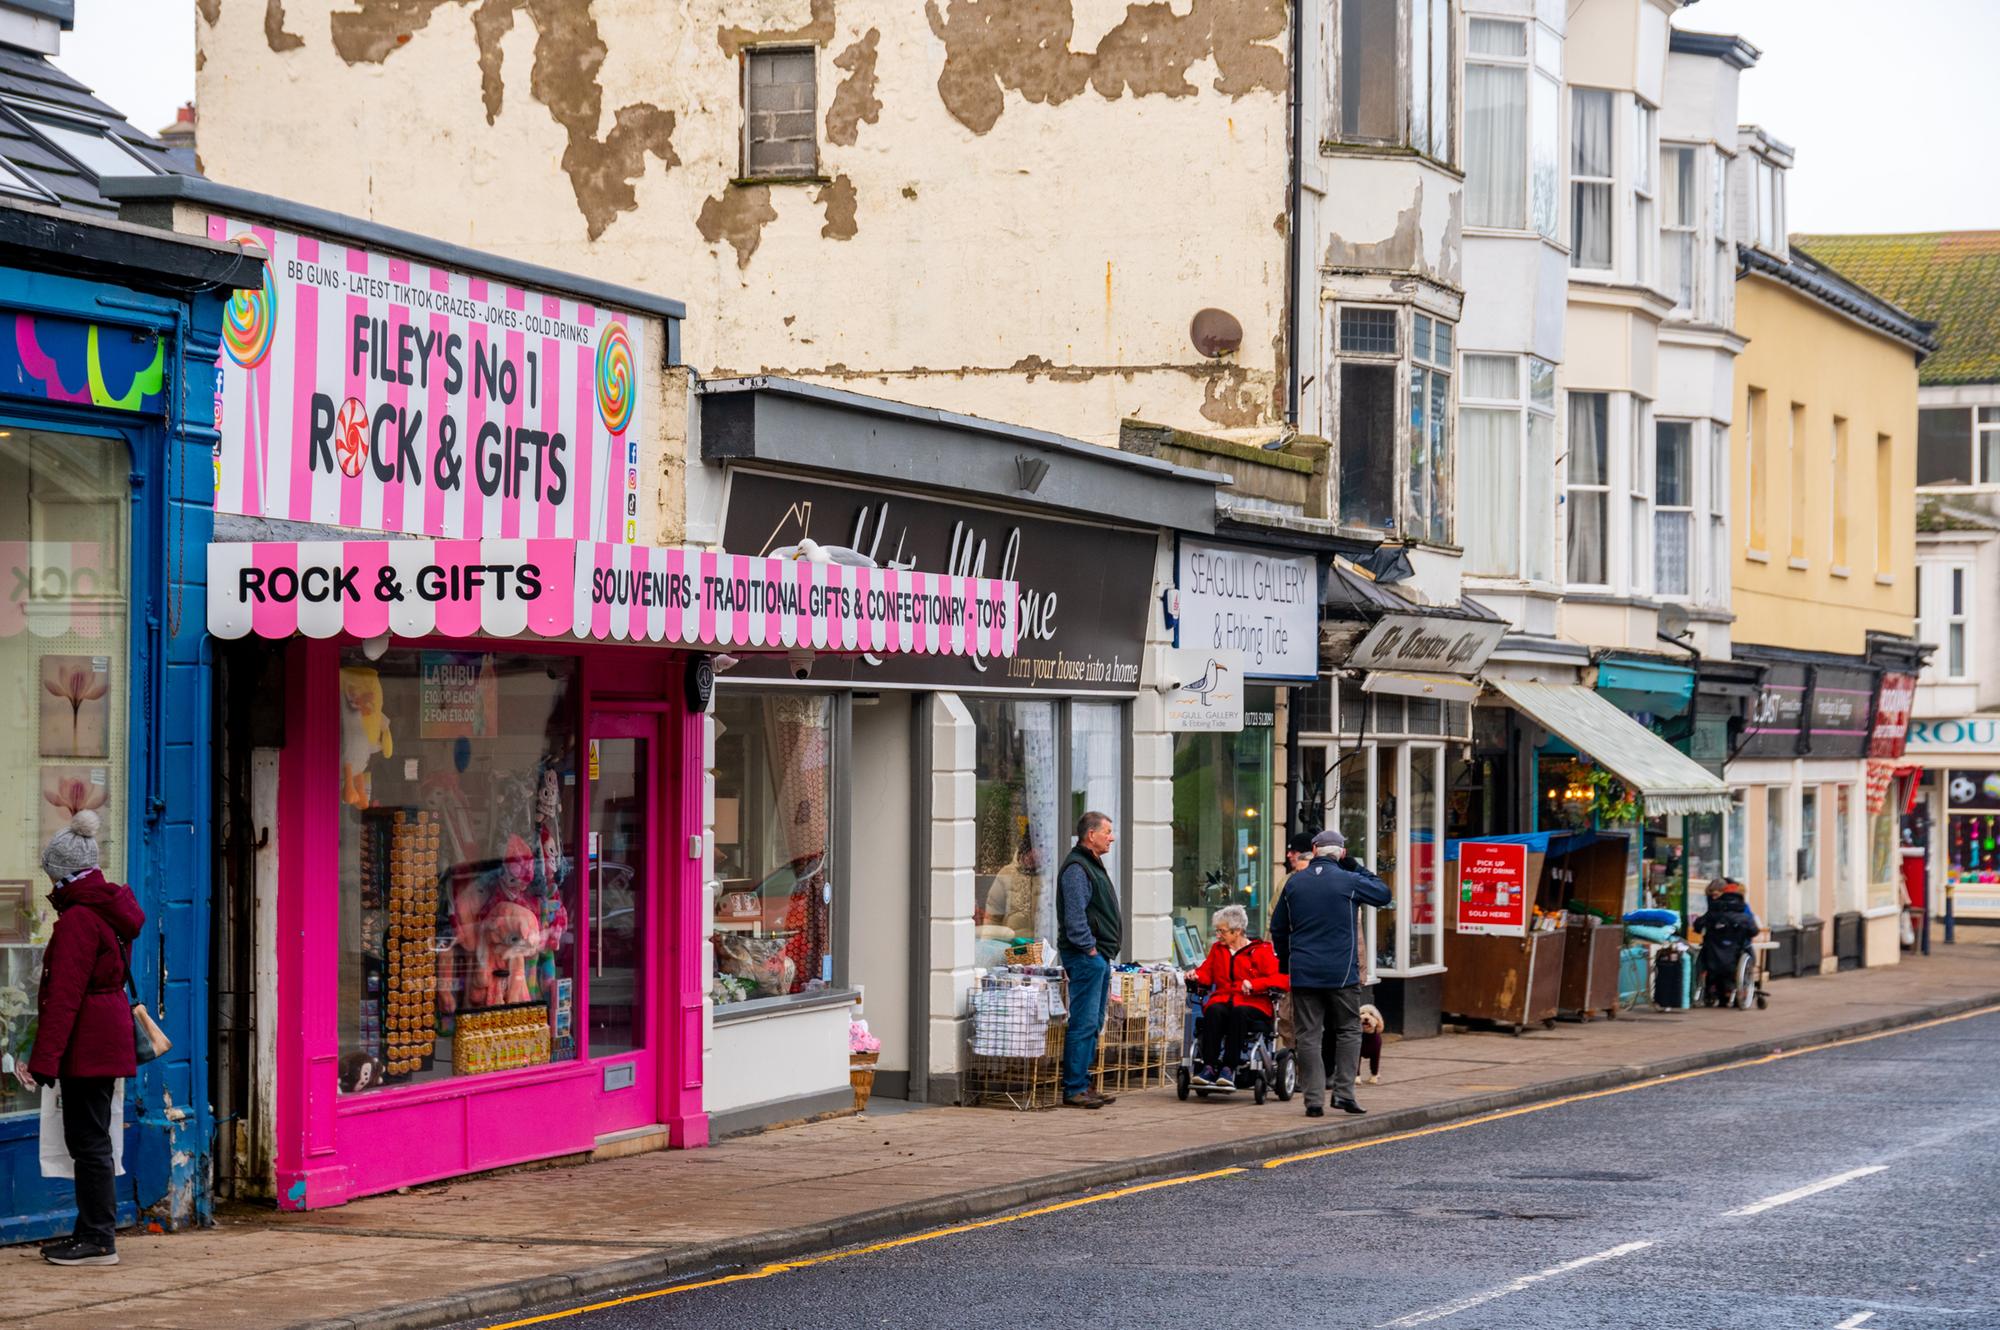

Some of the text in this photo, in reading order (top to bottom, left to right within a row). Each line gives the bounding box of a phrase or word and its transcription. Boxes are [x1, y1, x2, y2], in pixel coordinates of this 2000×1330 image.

[287, 260, 303, 280] BB
[306, 265, 340, 289] GUNS
[349, 274, 391, 300] LATEST
[393, 284, 433, 310] TIKTOK
[435, 294, 476, 320] CRAZES
[484, 305, 517, 329] JOKES
[525, 315, 551, 336] COLD
[553, 322, 589, 345] DRINKS
[353, 314, 537, 409] FILEY'S No 1
[434, 414, 463, 491] &
[475, 421, 567, 506] GIFTS
[239, 563, 542, 603] ROCK & GIFTS
[1191, 552, 1308, 604] SEAGULL GALLERY
[592, 567, 691, 609] SOUVENIRS
[704, 576, 806, 616] TRADITIONAL
[809, 584, 850, 619] GIFTS
[853, 588, 864, 620] &
[867, 589, 966, 627] CONFECTIONRY
[976, 598, 1006, 630] TOYS
[1213, 613, 1288, 665] & Ebbing Tide
[423, 664, 475, 686] LABUBU
[1007, 651, 1138, 687] Turn your house into a home
[424, 690, 475, 704] £10.00 EACH
[424, 708, 429, 722] 2
[431, 709, 448, 722] FOR
[1205, 711, 1239, 720] GALLERY
[1212, 720, 1227, 728] Tide
